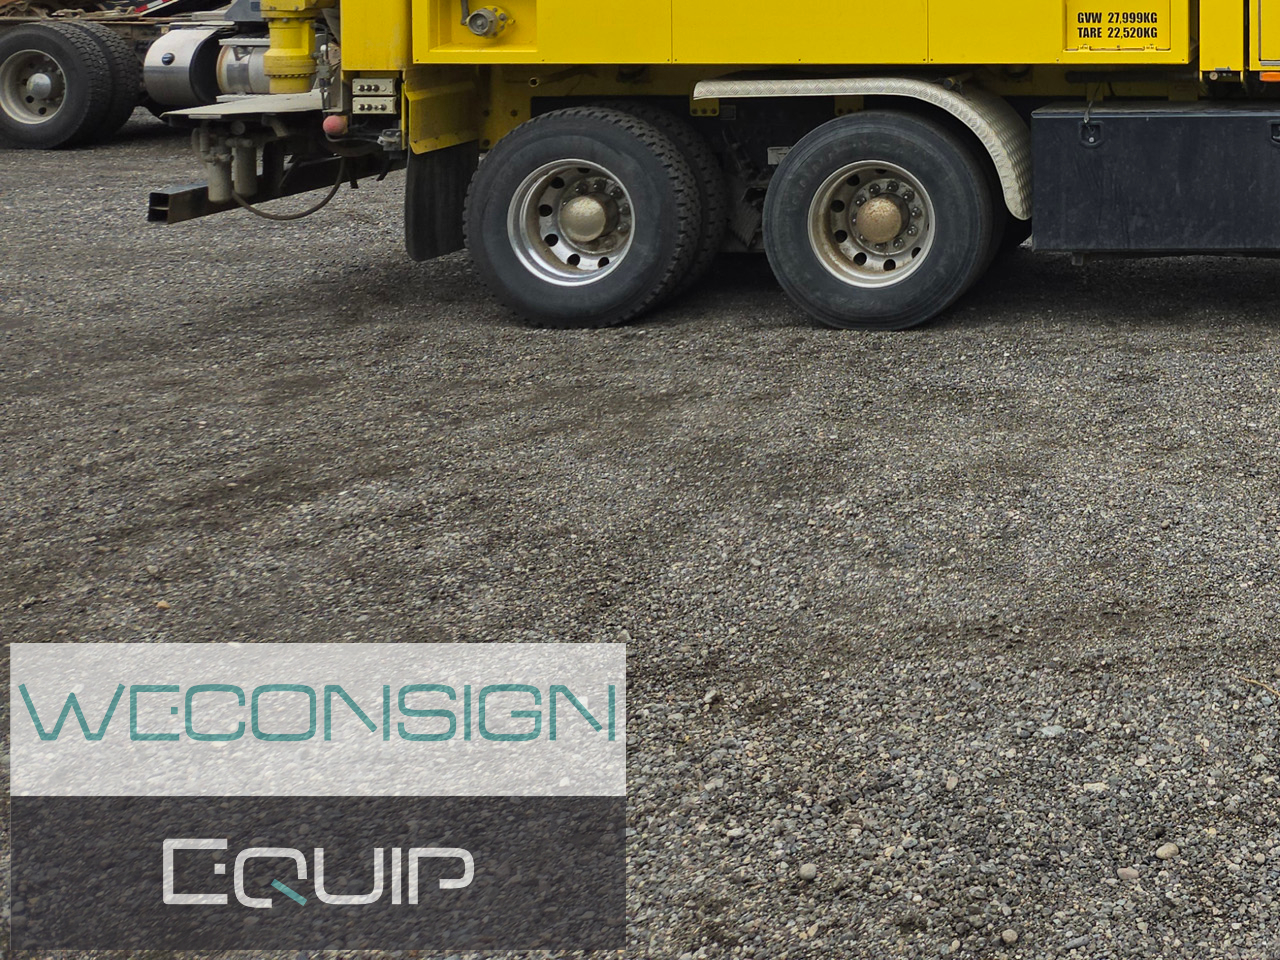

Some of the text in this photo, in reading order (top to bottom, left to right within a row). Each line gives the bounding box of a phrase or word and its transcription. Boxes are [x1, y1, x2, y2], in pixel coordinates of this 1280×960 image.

[1077, 12, 1158, 24] GVW 27,999KG
[1077, 27, 1158, 39] TARE 22,520KG
